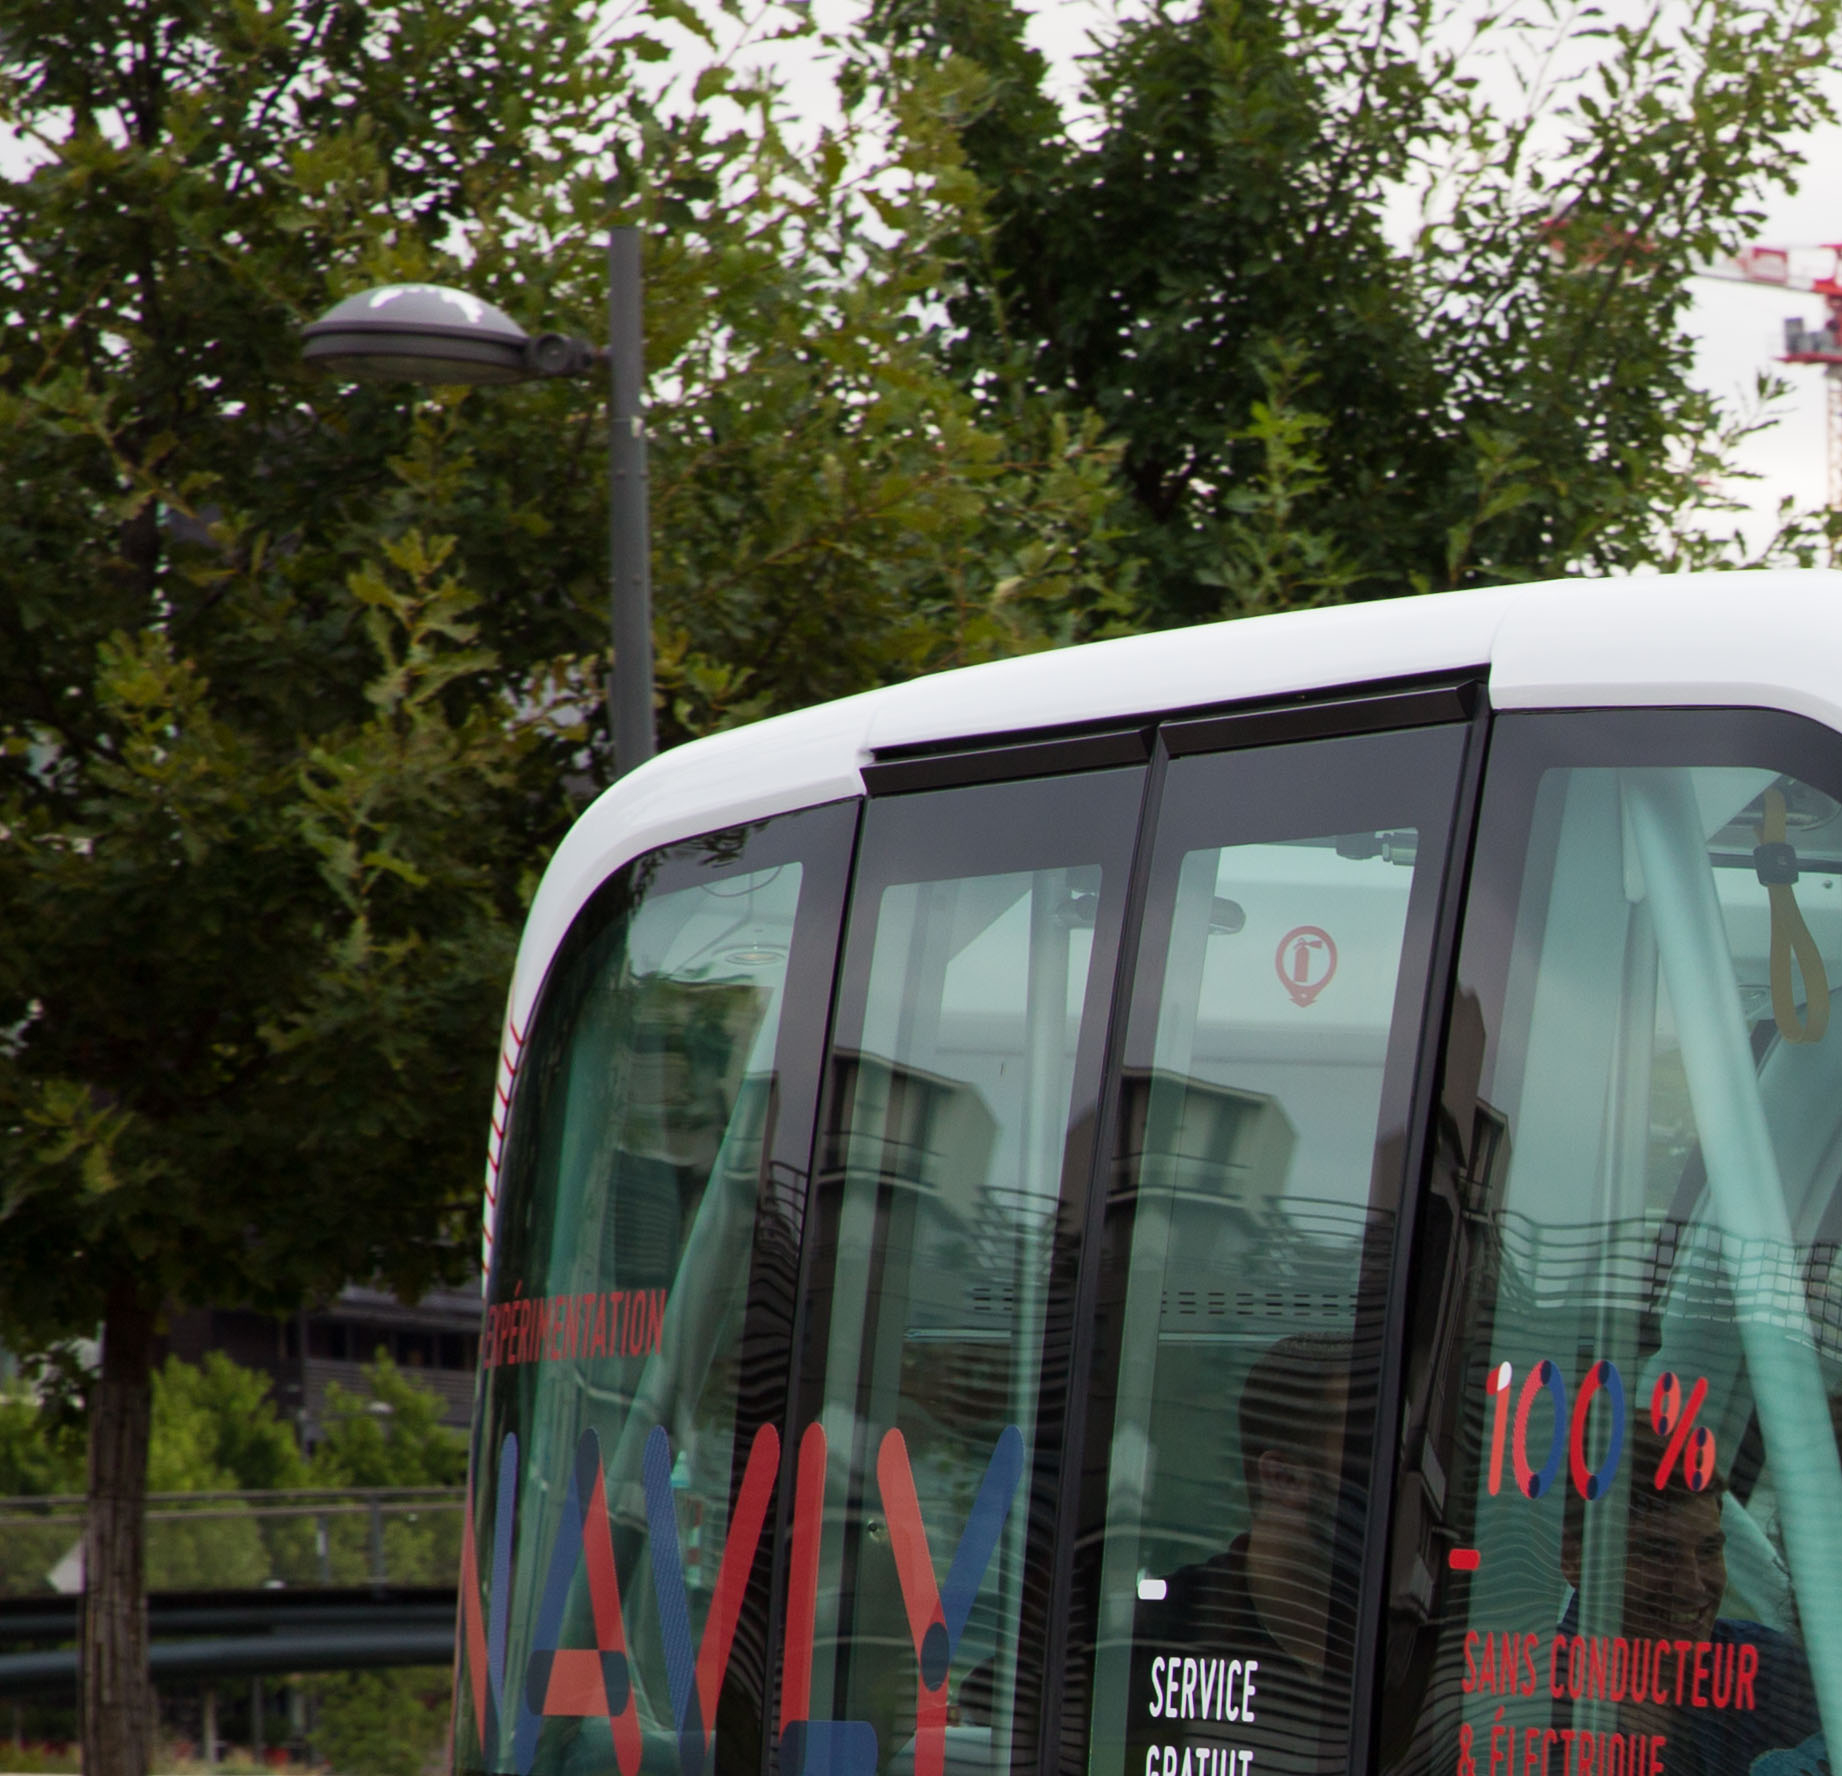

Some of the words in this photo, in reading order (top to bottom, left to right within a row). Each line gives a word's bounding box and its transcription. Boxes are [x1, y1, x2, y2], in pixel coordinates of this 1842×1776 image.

[1486, 1359, 1626, 1500] 100
[1651, 1371, 1717, 1492] %
[1149, 1656, 1260, 1724] SERVICE
[1460, 1630, 1539, 1696] SANS
[1549, 1633, 1759, 1712] CONDUCTEUR
